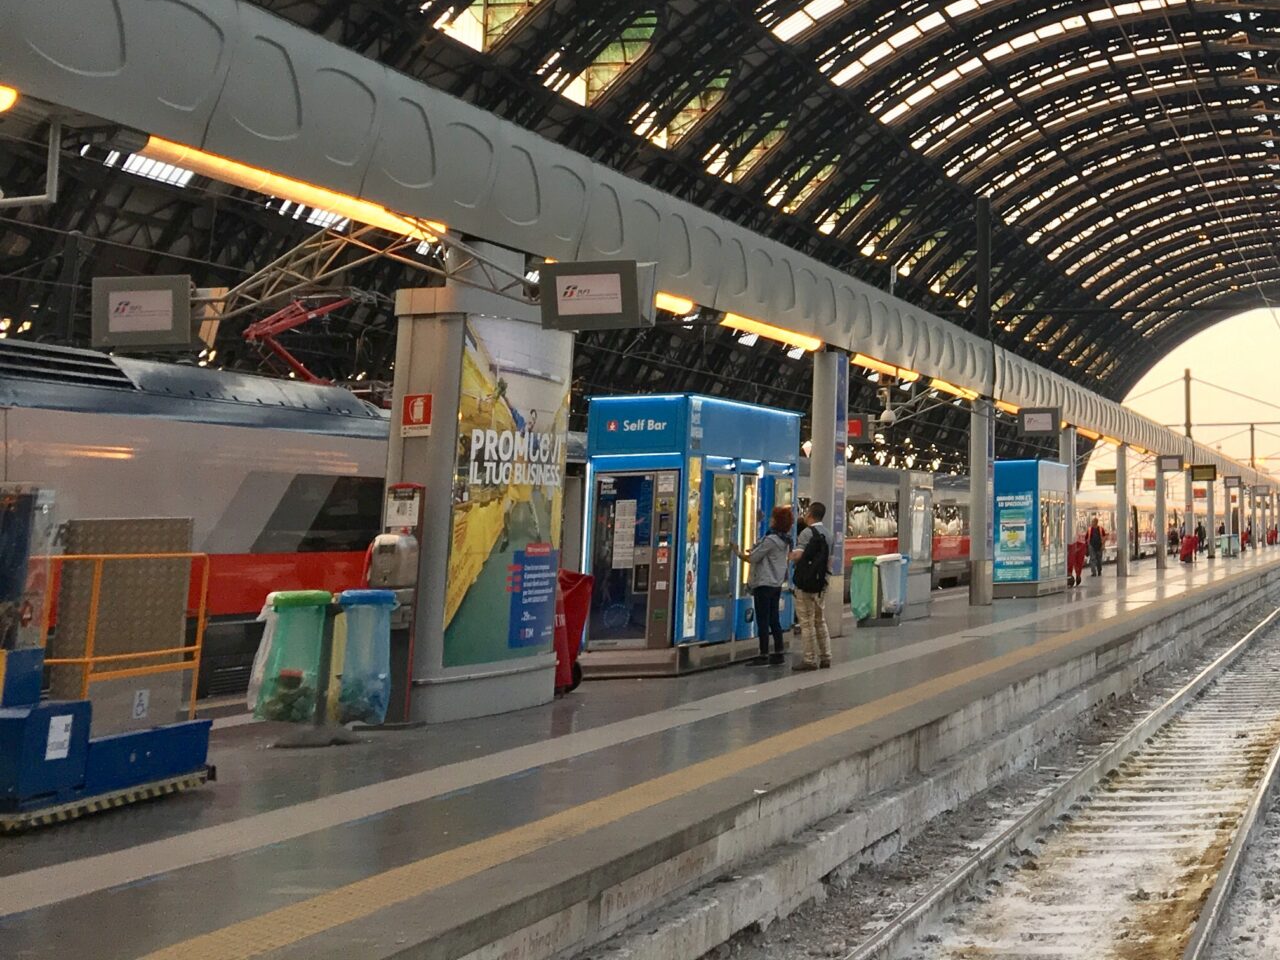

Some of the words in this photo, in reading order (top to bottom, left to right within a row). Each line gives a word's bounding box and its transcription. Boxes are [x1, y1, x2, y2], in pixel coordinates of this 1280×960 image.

[623, 419, 645, 431] Self
[647, 419, 667, 431] Bar
[469, 461, 482, 485] IL
[484, 461, 512, 485] TUO
[514, 463, 560, 486] BUSINESS
